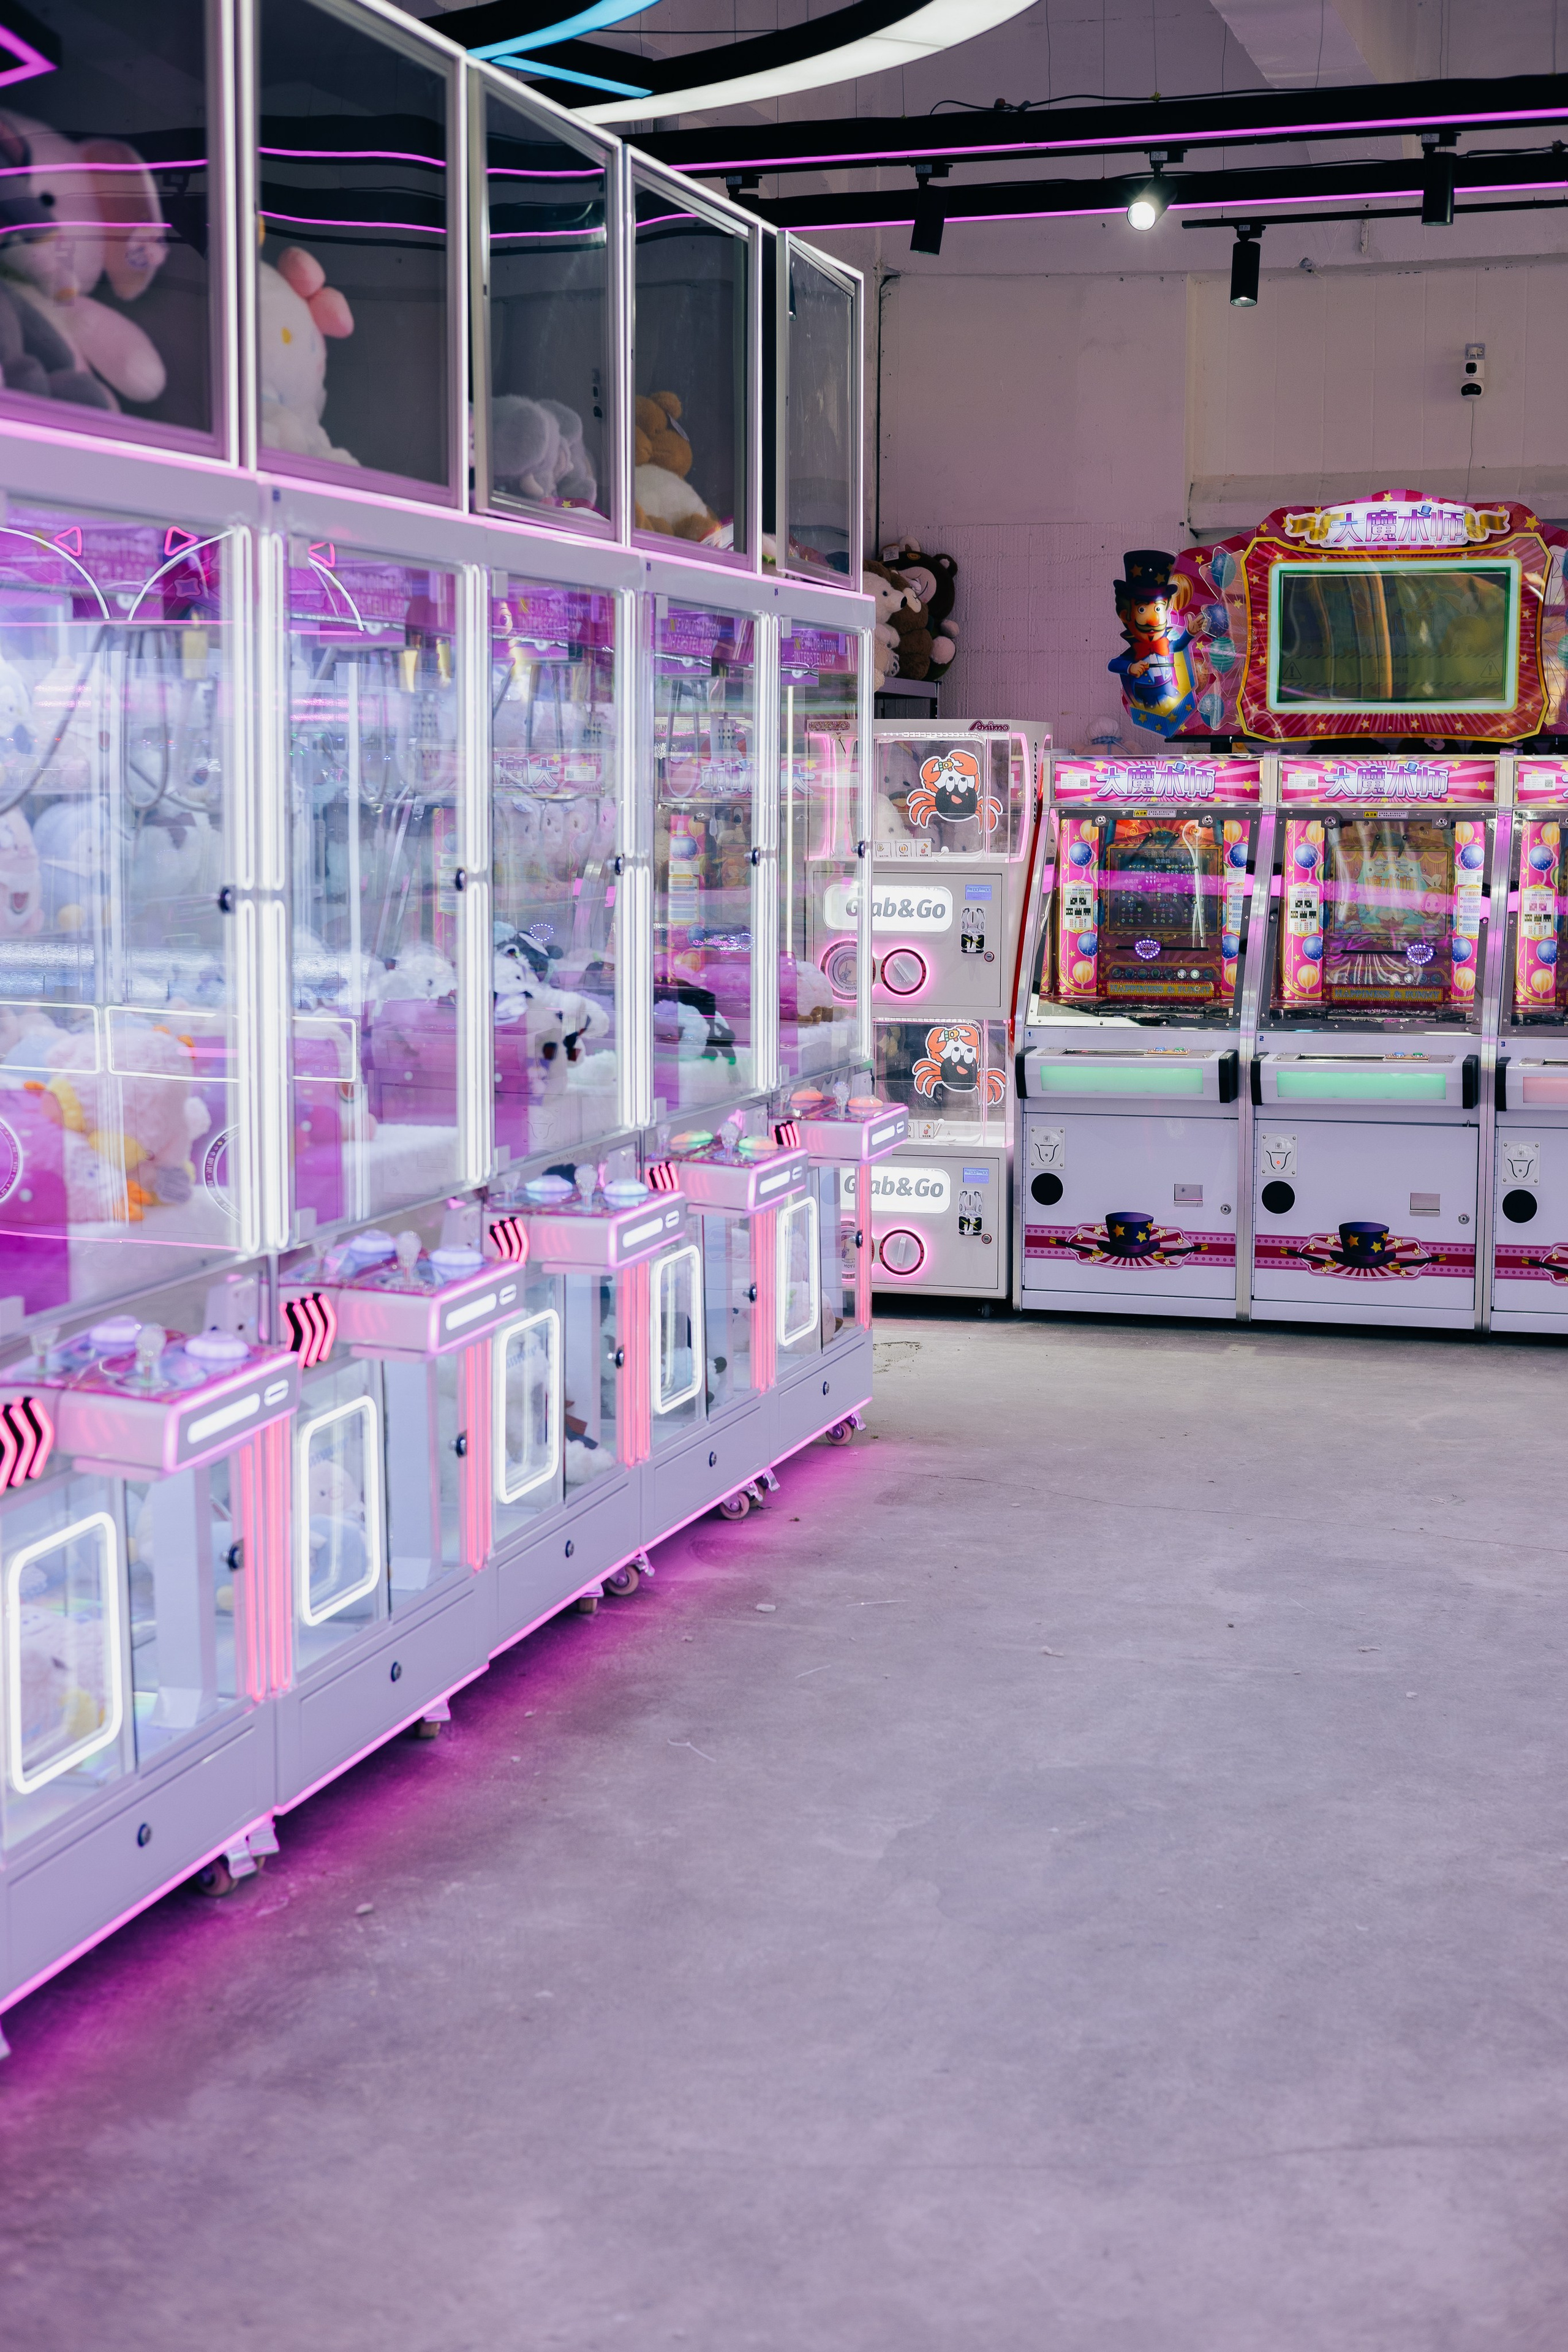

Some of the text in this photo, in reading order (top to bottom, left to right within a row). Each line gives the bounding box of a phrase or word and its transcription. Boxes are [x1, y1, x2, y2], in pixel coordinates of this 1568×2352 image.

[1332, 508, 1464, 544] 大魔术师
[794, 650, 832, 667] INTERSTELLAR
[968, 720, 1009, 732] Animo
[1096, 764, 1216, 797] 大魔术师
[1324, 763, 1450, 799] 大魔术师
[846, 896, 946, 918] Gab&Go
[1110, 984, 1164, 993] HAPPINESS
[1335, 989, 1390, 998] HAPPINESS
[1405, 990, 1439, 999] FUNNY
[845, 1175, 944, 1198] Gab&Go
